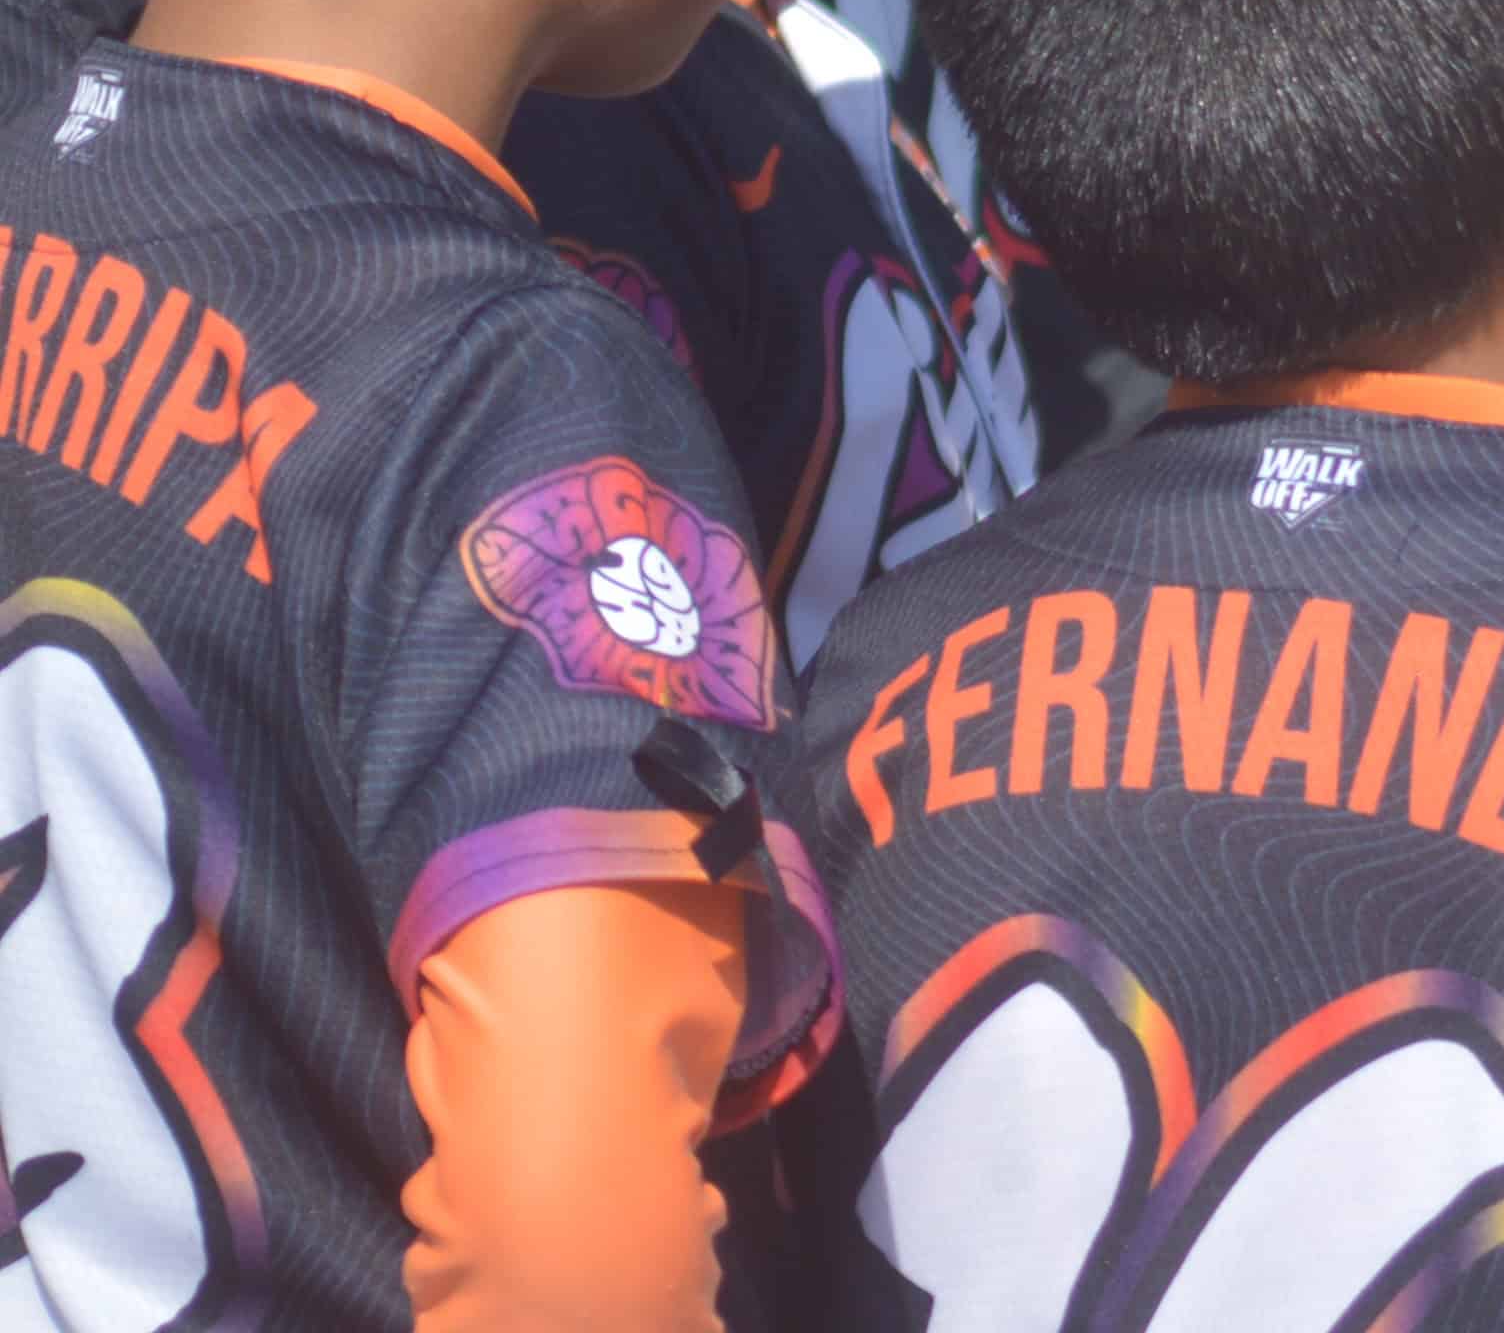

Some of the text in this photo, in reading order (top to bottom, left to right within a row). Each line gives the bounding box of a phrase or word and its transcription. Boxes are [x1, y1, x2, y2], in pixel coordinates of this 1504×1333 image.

[0, 223, 319, 586] RRIPA
[1257, 447, 1364, 487] WALK
[1251, 480, 1314, 512] OFF
